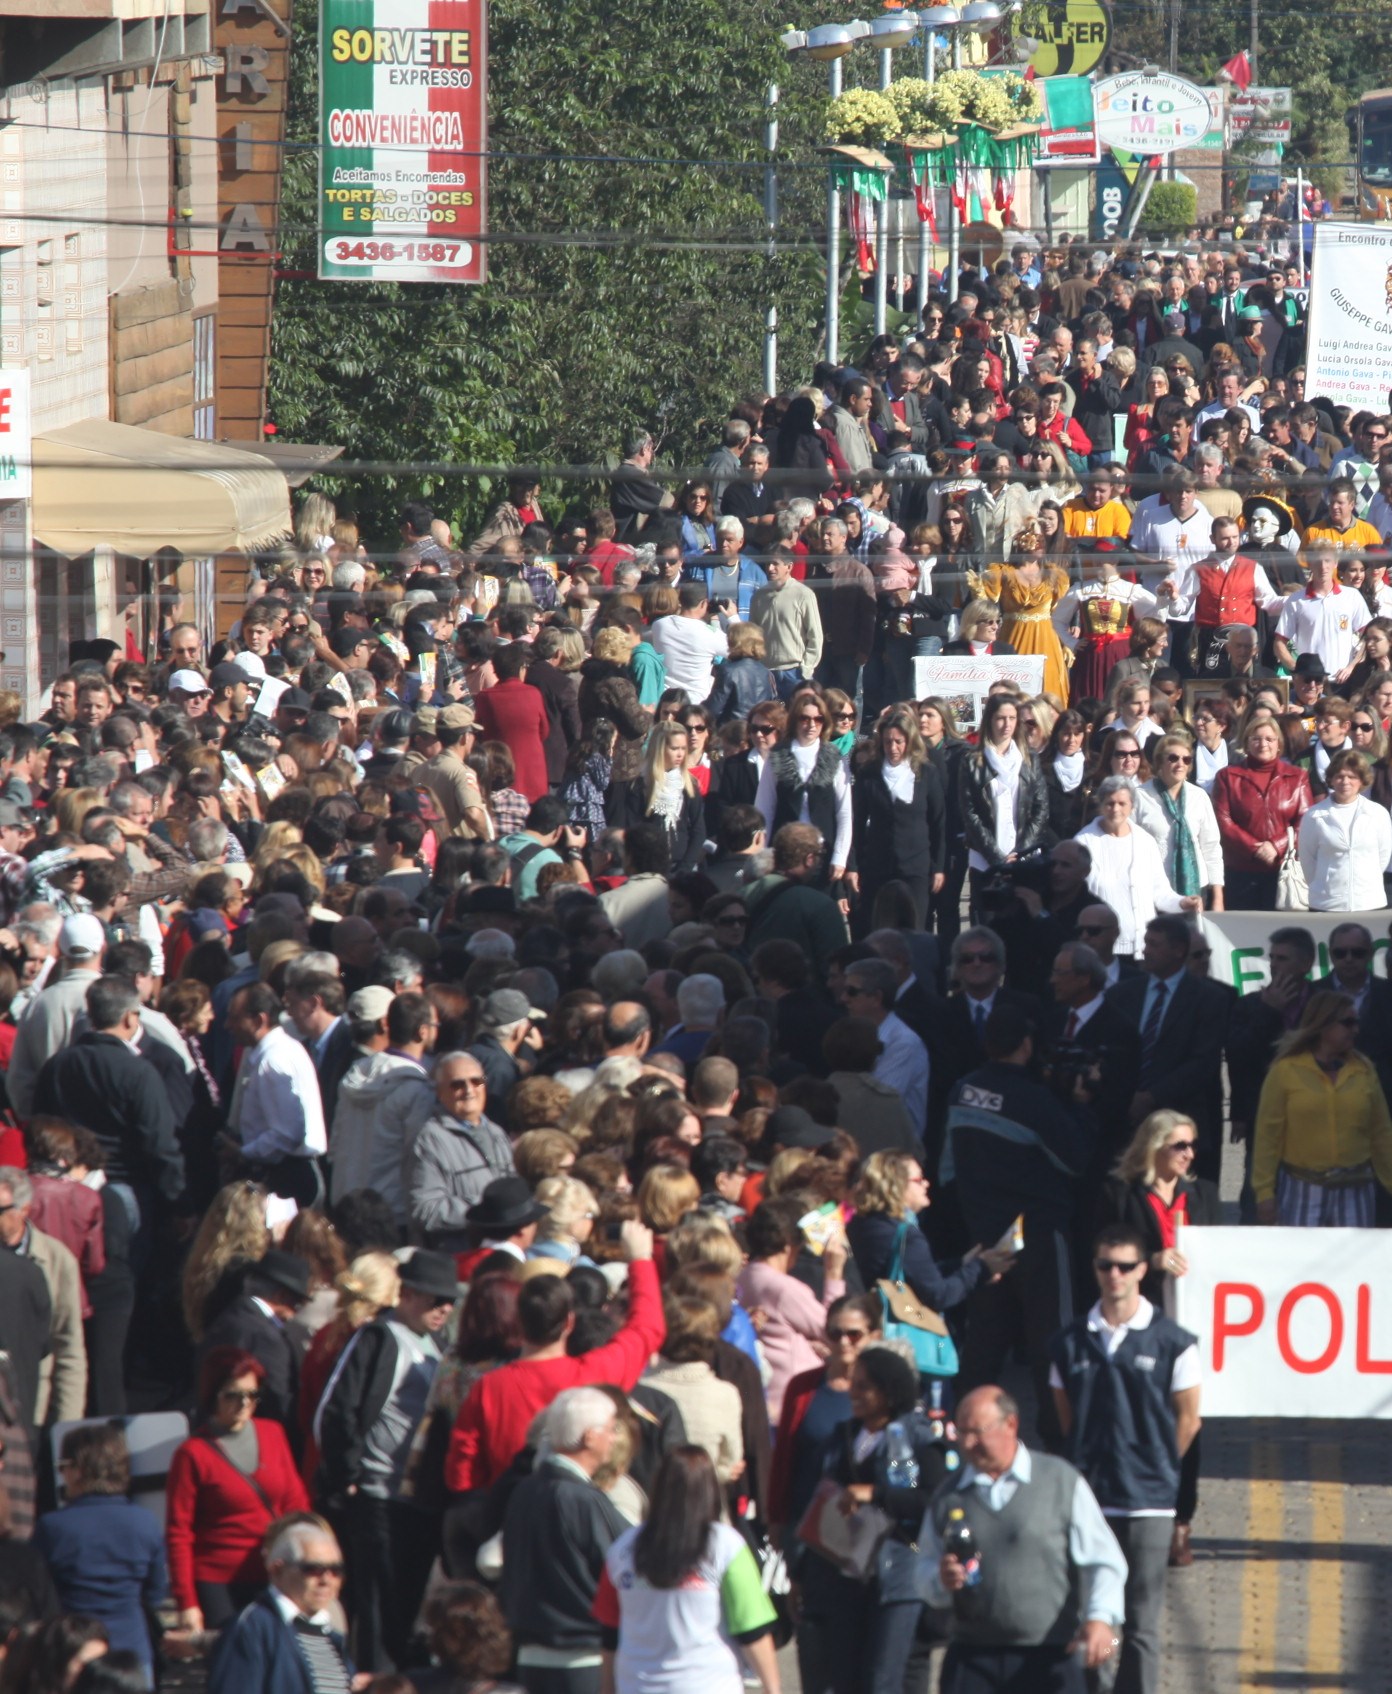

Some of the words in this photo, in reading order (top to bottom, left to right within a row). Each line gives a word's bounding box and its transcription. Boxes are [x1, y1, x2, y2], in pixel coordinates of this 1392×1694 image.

[331, 27, 471, 65] SORVETE
[389, 69, 472, 88] EXPRESSO
[1140, 77, 1170, 88] Infantil
[1177, 84, 1203, 105] Jovem
[1100, 92, 1175, 113] Jeito
[330, 108, 463, 147] CONVENIÊNCIA
[1130, 115, 1198, 136] Mais
[334, 167, 392, 182] Aceitamos
[395, 170, 465, 184] Encomendas
[325, 188, 397, 204] TORTAS
[412, 190, 474, 206] DOCES
[342, 206, 355, 221] E
[359, 207, 457, 223] SALGADOS
[1338, 232, 1386, 247] Encontro
[335, 241, 462, 263] 3436-1587
[1330, 287, 1373, 328] GIUSEPPE
[1318, 338, 1341, 351] Luigi
[1343, 338, 1374, 351] Andrea
[1317, 353, 1341, 364] Lucia
[1344, 355, 1372, 366] Orsola
[1317, 365, 1350, 377] Antonio
[1352, 369, 1374, 379] Gava
[1316, 379, 1346, 390] Andrea
[1349, 381, 1370, 392] Gava
[1346, 393, 1367, 404] Gava
[990, 666, 1031, 681] Gava
